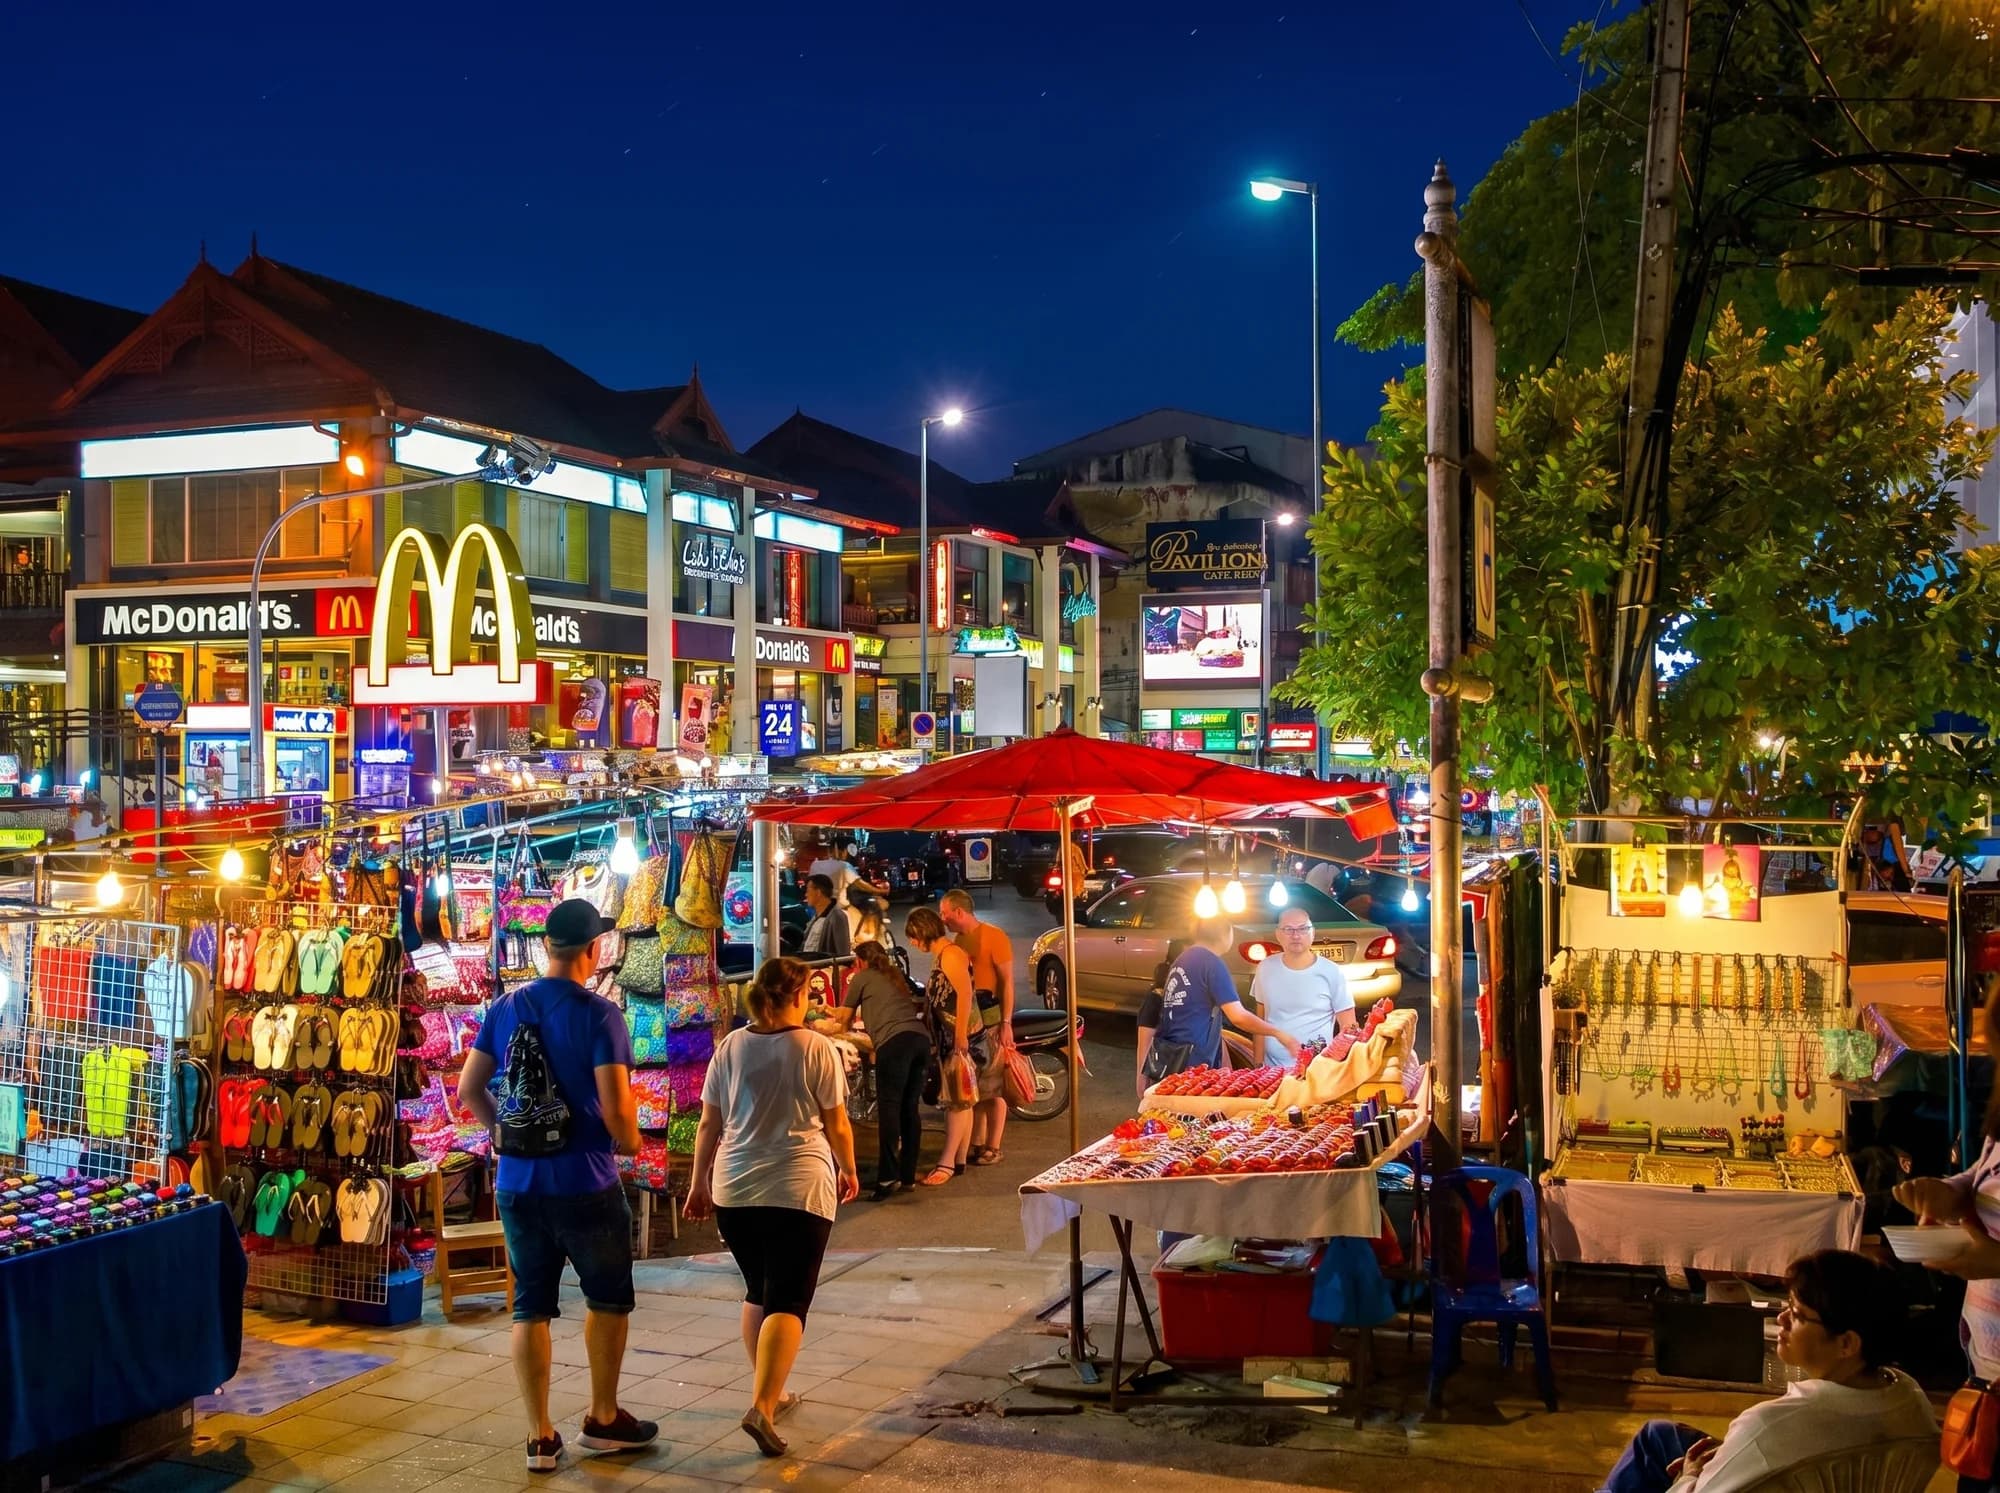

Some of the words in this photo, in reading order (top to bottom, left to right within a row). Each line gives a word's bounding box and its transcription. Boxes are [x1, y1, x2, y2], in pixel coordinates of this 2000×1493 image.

[1150, 530, 1264, 569] PAVILION
[471, 605, 581, 643] Mcald's
[765, 712, 793, 736] 24
